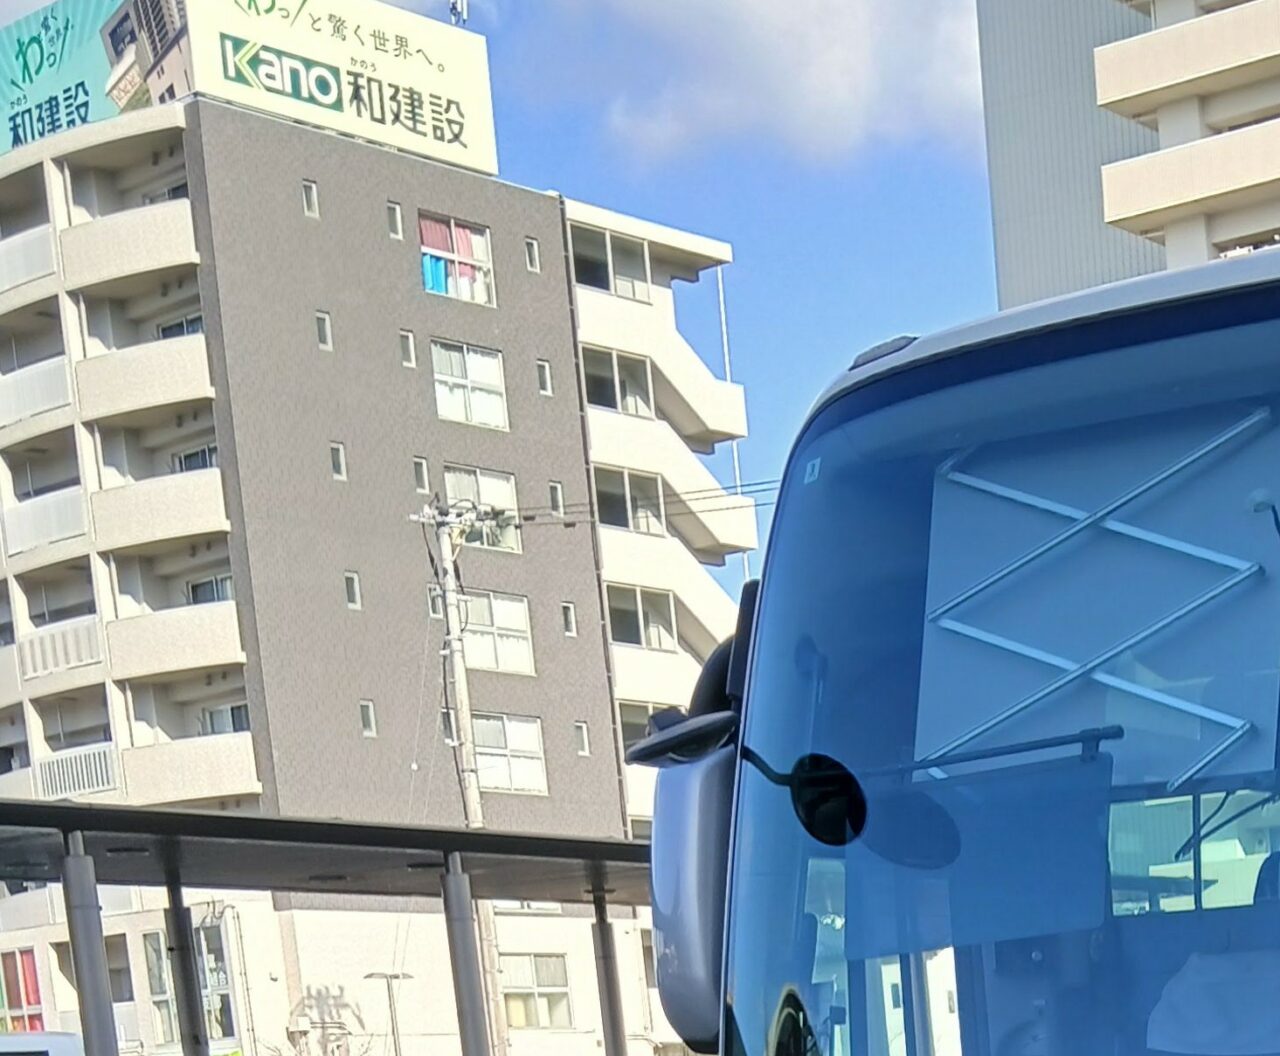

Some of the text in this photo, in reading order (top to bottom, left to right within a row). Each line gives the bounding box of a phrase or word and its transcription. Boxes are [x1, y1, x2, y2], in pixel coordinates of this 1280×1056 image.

[8, 80, 90, 149] 和建設
[223, 39, 468, 149] Kano 和建設
